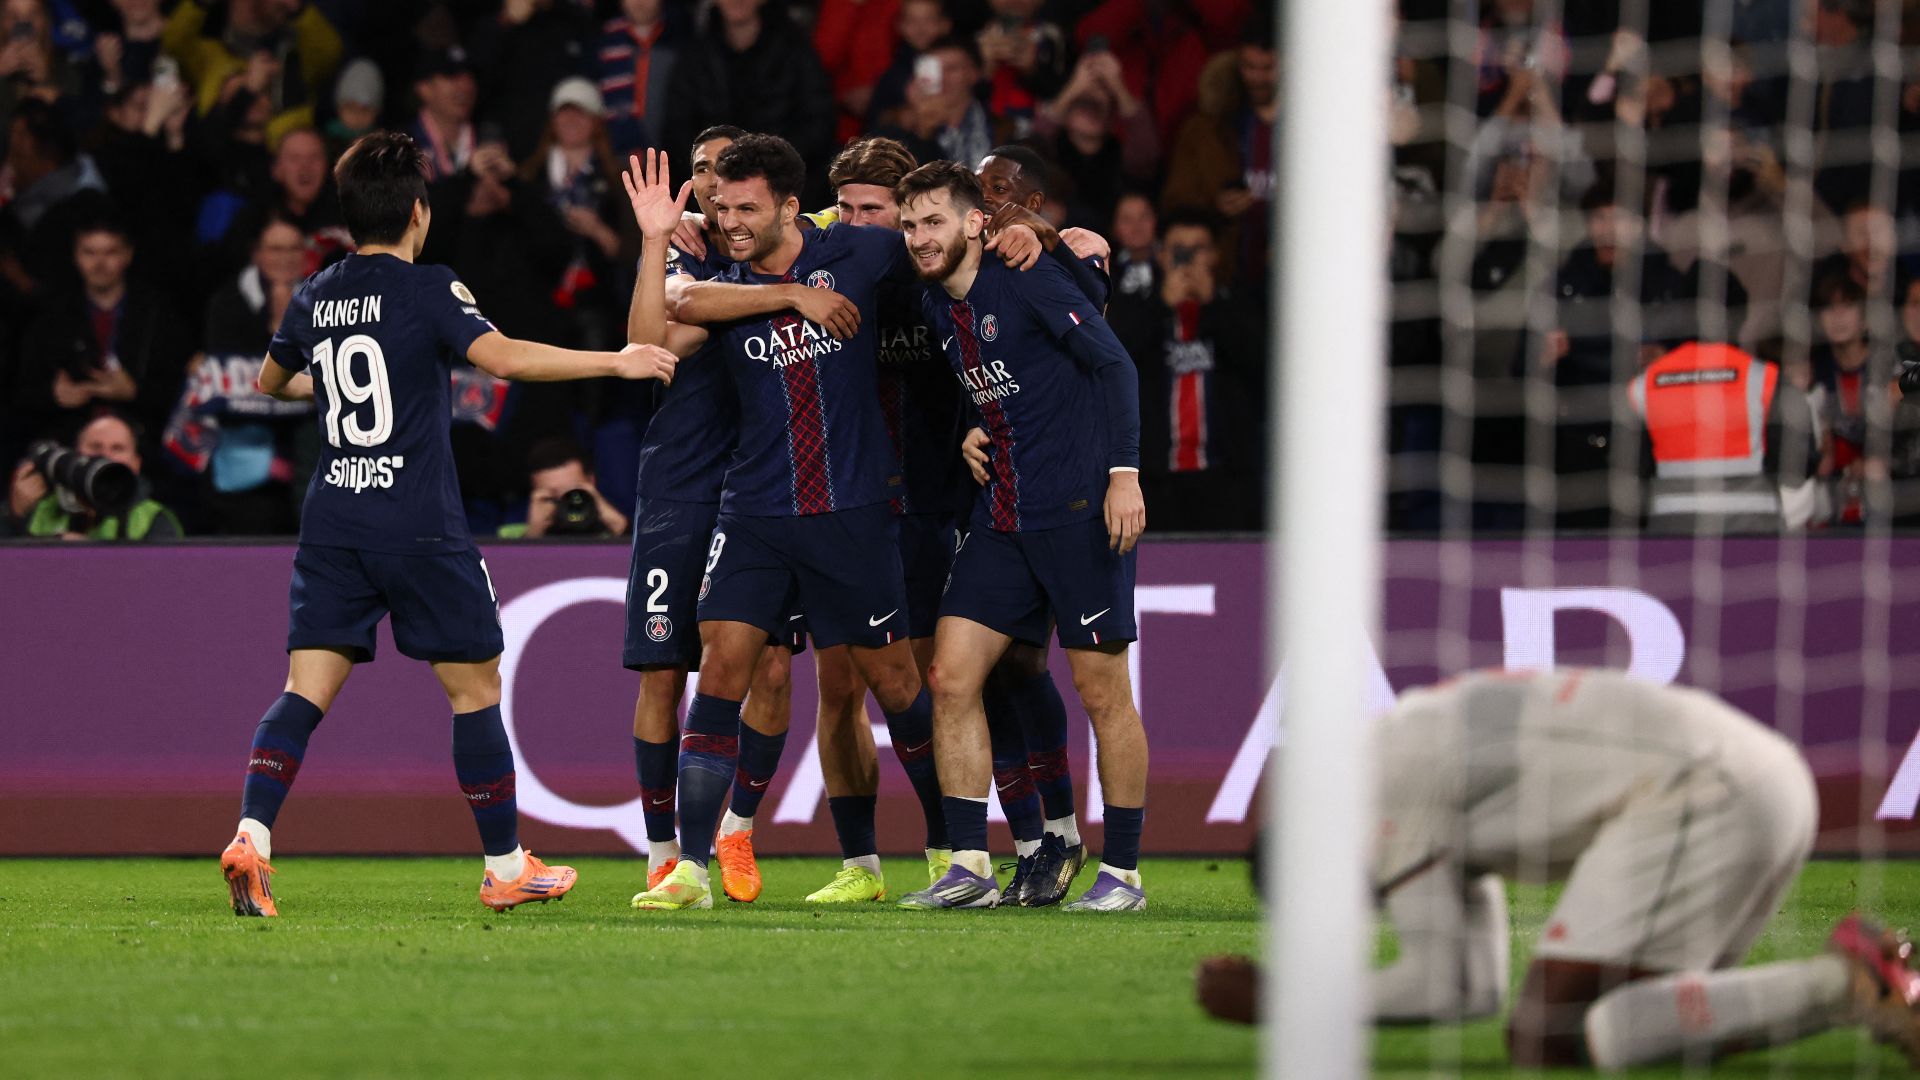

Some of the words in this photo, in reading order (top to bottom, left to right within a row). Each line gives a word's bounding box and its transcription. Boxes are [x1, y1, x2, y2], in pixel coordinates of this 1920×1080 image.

[312, 298, 359, 328] KANG
[361, 295, 382, 324] IN
[881, 325, 929, 348] TAR
[773, 337, 842, 370] AIRWAYS
[878, 347, 932, 364] RWAYS
[312, 334, 394, 448] 19
[956, 360, 1012, 391] ATAR
[971, 379, 1020, 405] AIRWAYS
[324, 456, 394, 494] snipes
[705, 532, 727, 573] 9
[646, 568, 669, 613] 2
